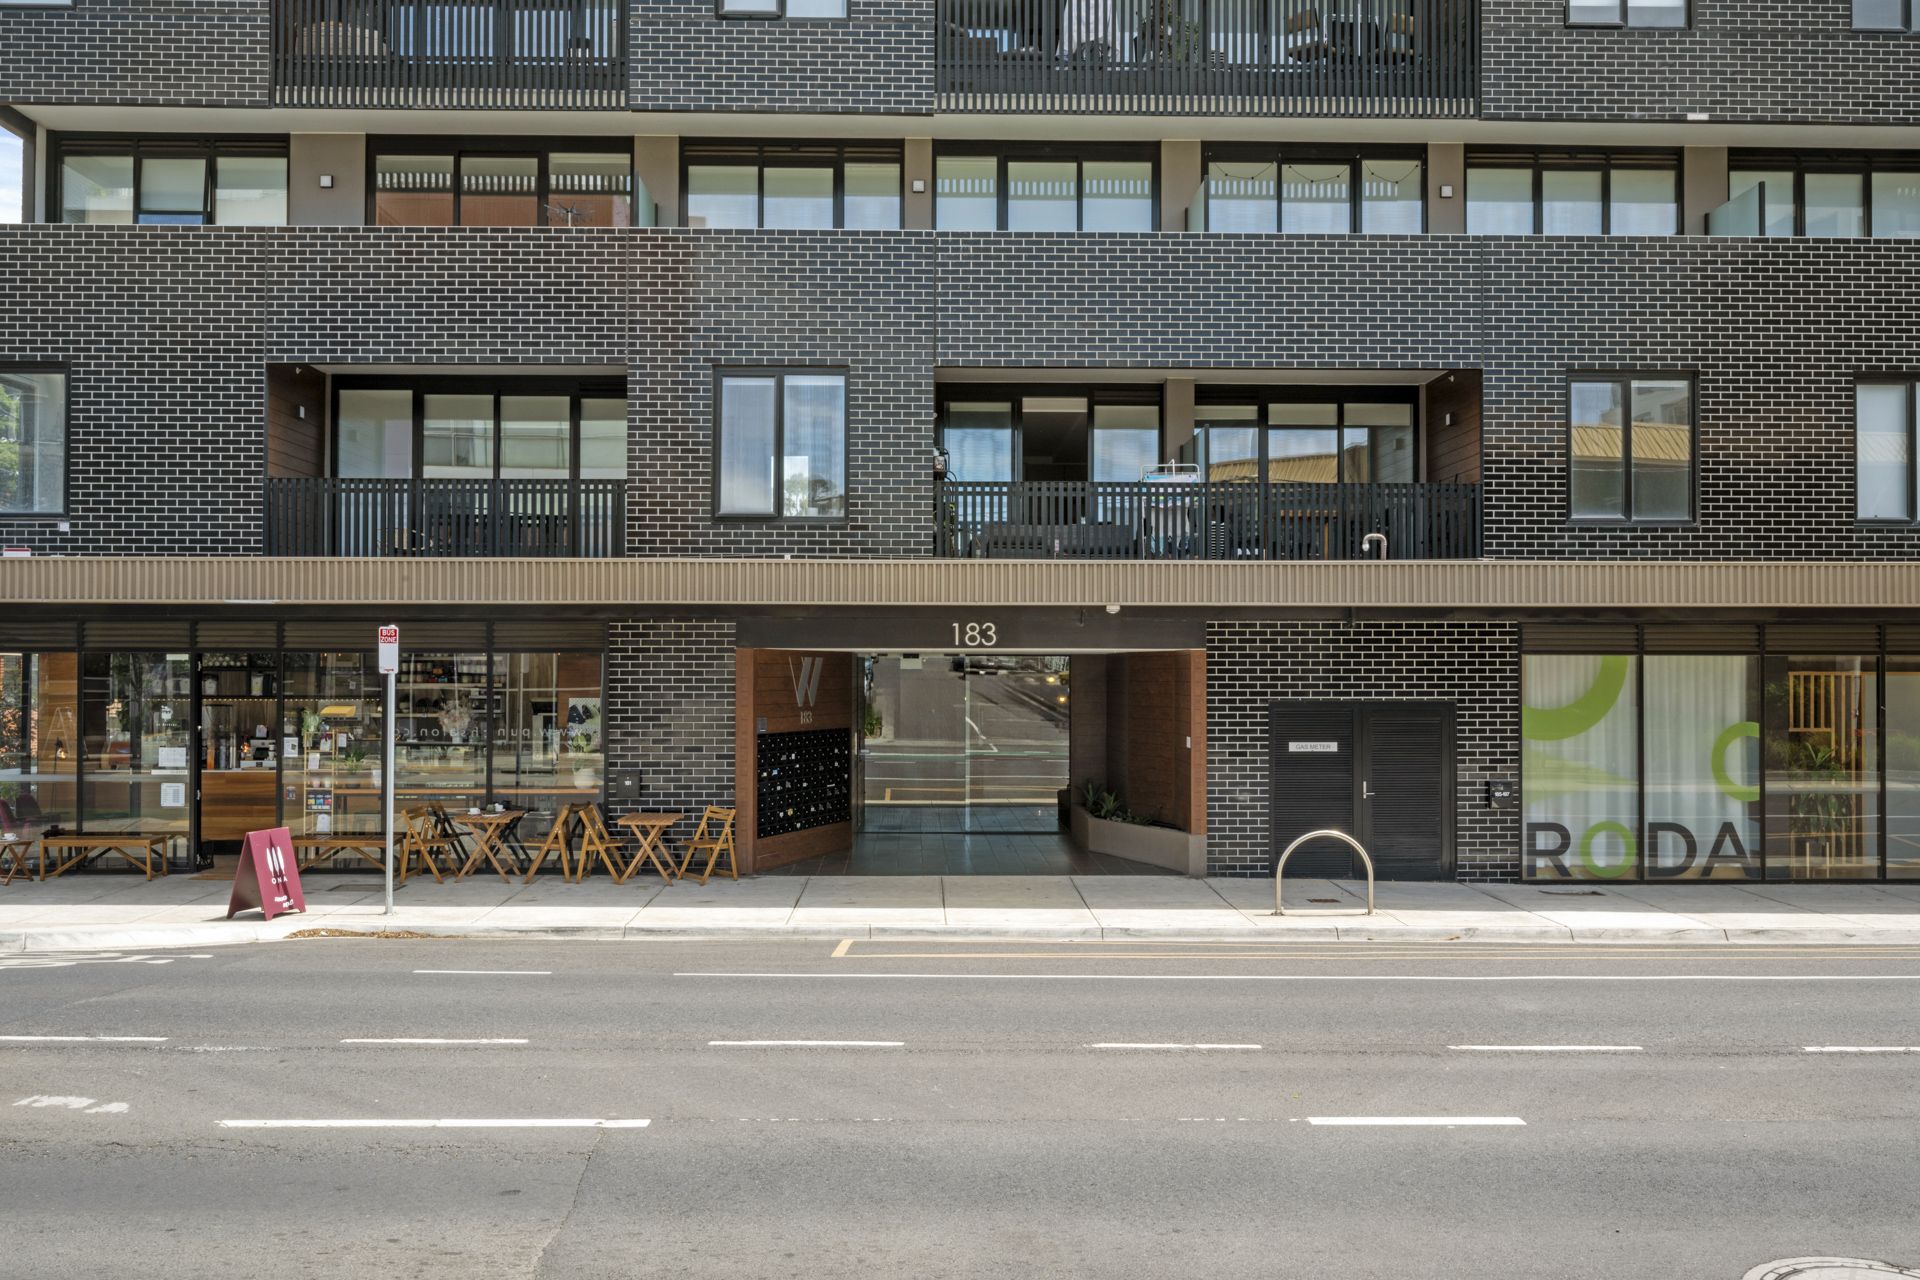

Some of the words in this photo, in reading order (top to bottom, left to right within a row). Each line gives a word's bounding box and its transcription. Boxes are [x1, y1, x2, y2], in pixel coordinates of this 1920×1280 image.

[952, 622, 997, 646] 183
[800, 711, 813, 725] 183
[1526, 820, 1755, 878] RODA
[271, 876, 288, 885] ONA
